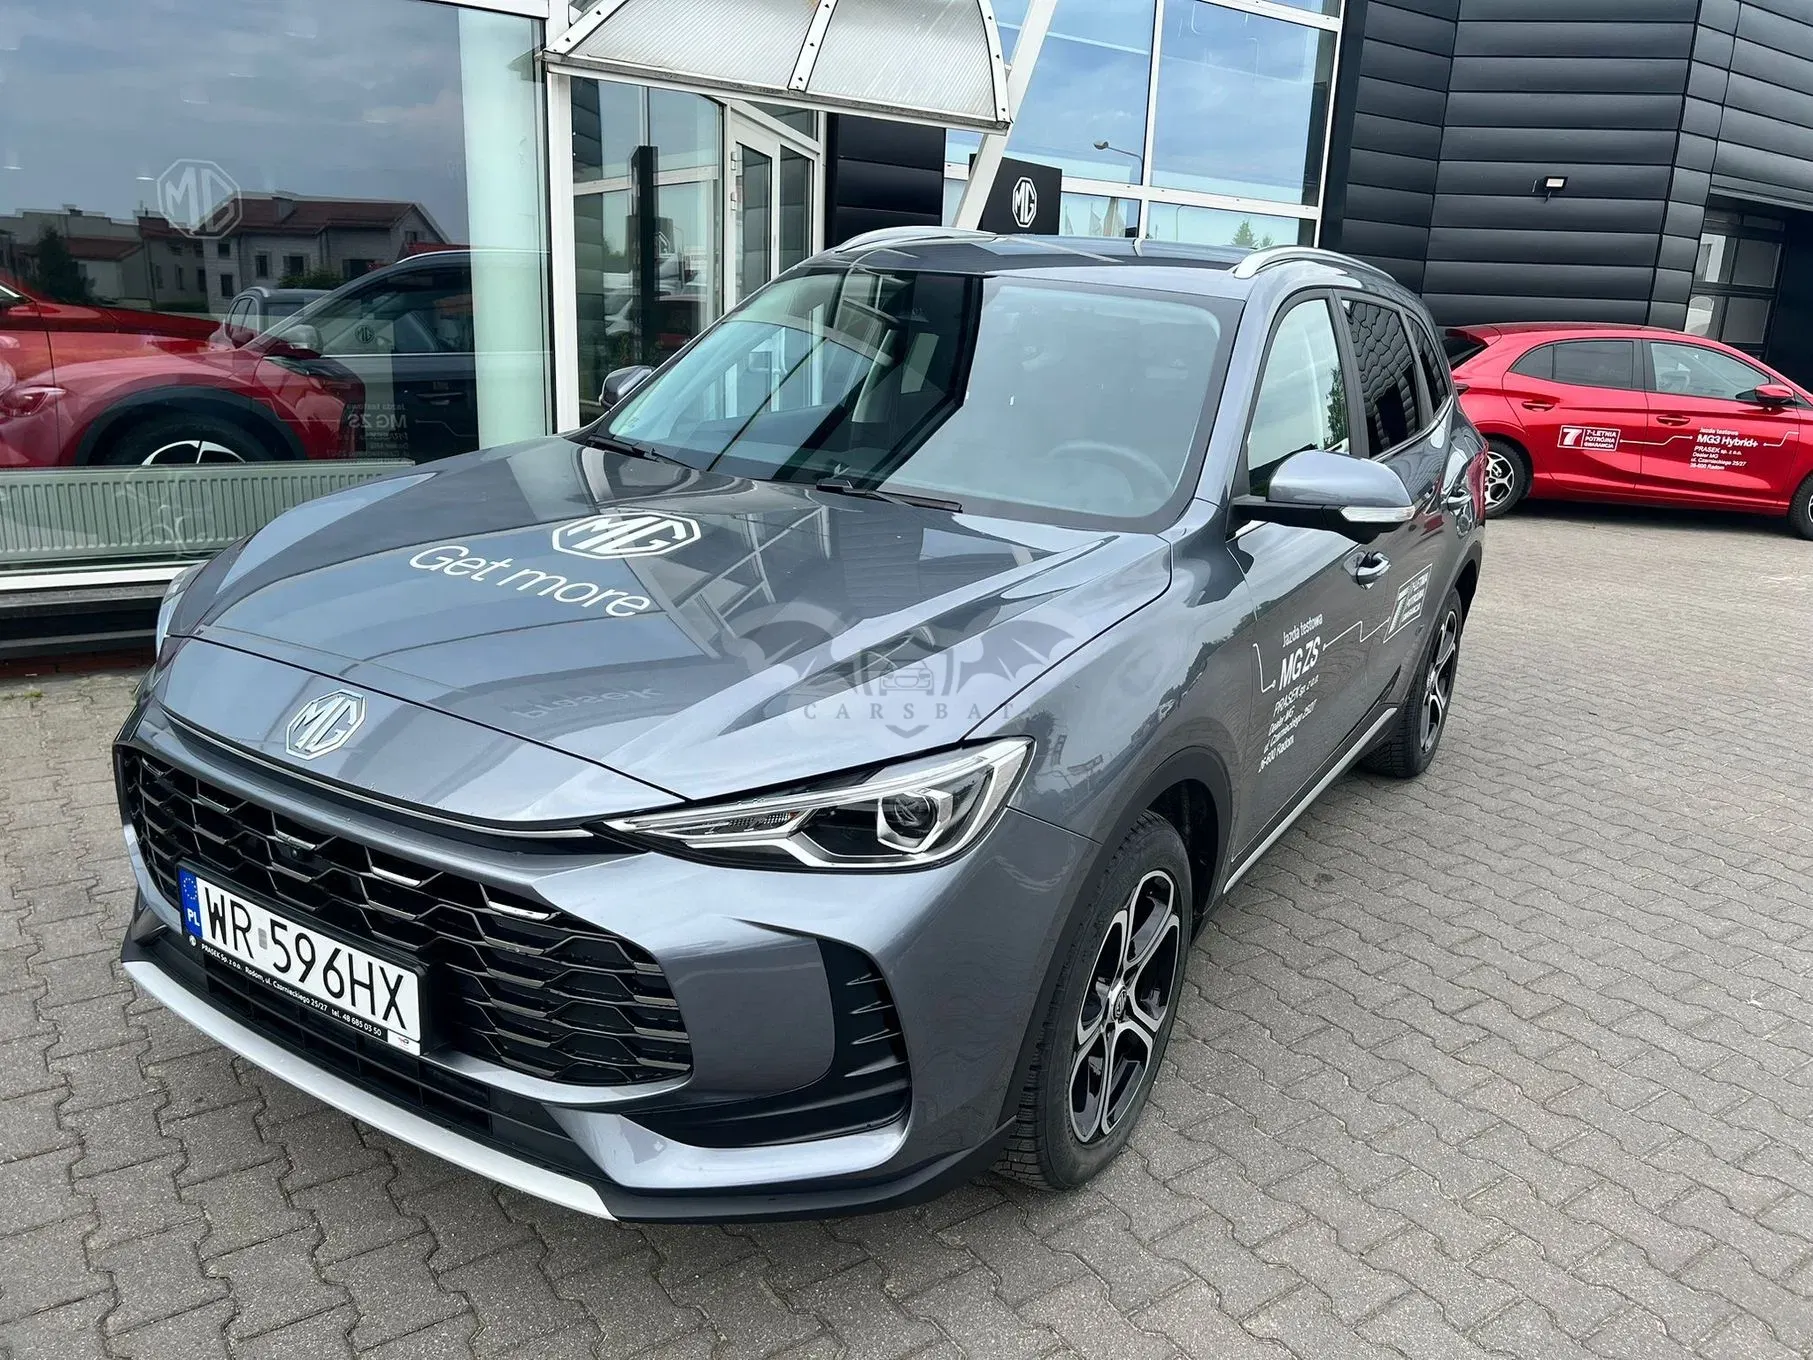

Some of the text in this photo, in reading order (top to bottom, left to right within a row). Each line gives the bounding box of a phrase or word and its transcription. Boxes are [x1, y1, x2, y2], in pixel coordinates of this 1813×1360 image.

[1013, 179, 1036, 225] MG
[1563, 428, 1582, 446] 7
[1586, 430, 1616, 438] 7-LETNIA
[1696, 434, 1758, 448] MG3 Hybrid+
[559, 514, 694, 557] MG
[409, 545, 514, 582] Get
[496, 567, 651, 617] more
[1282, 613, 1323, 648] Jazda testowa
[1278, 636, 1321, 691] MG ZS
[289, 693, 362, 757] MG
[187, 908, 200, 927] PL
[201, 943, 220, 960] PRASEK
[204, 886, 408, 1030] WR 596HX
[311, 998, 328, 1012] 25/27
[331, 1008, 382, 1036] tel. 48 685 03 50
